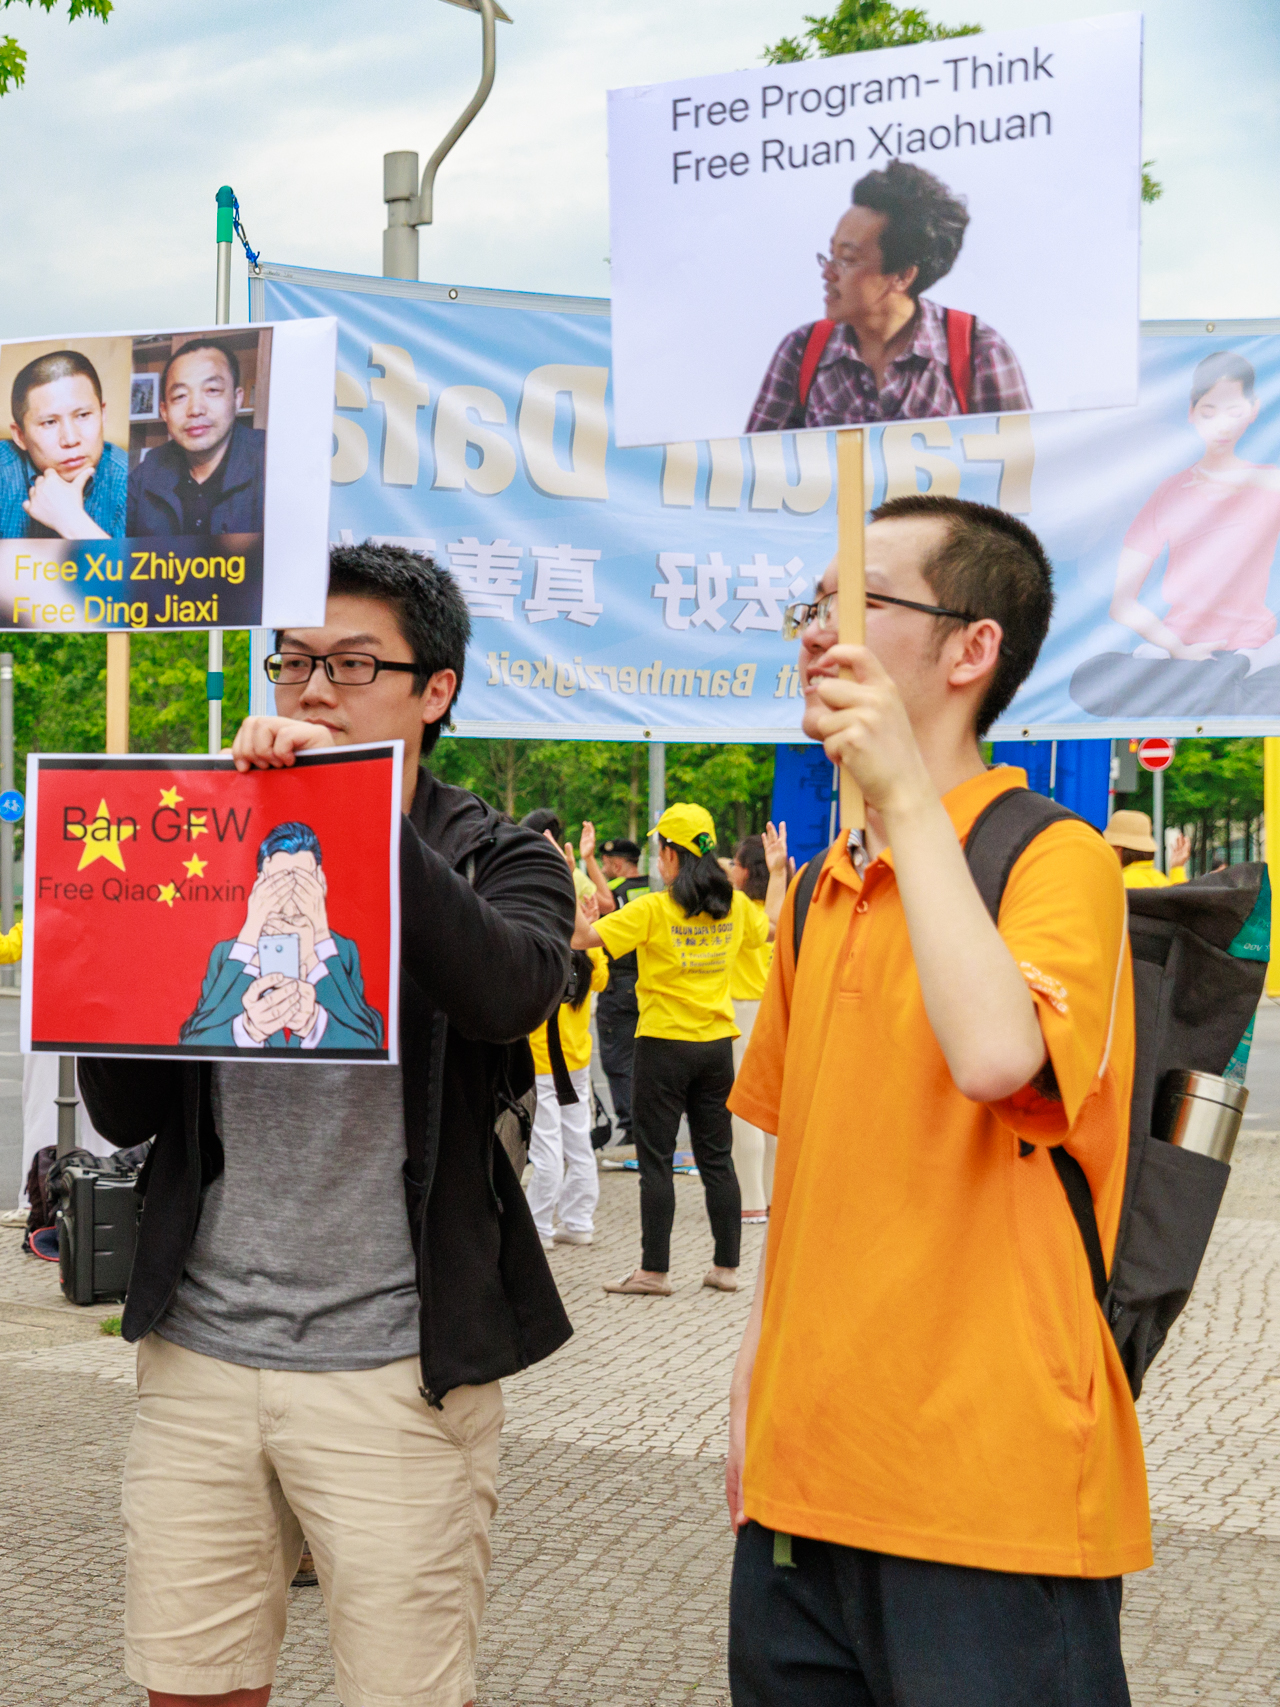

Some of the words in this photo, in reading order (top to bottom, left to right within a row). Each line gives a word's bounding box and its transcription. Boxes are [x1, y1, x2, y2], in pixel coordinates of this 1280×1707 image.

[671, 96, 749, 131] Free
[761, 46, 1054, 118] Program-Think
[672, 150, 750, 184] Free
[761, 136, 855, 173] Ruan
[867, 109, 1052, 160] Xiaohuan
[14, 554, 79, 581] Free
[84, 553, 124, 582] Xu
[130, 551, 246, 585] Zhiyong
[13, 597, 76, 624] Free
[84, 596, 149, 628] Ding
[154, 593, 219, 623] Jiaxi
[62, 805, 138, 842] Ban
[151, 806, 252, 842] GFW
[38, 876, 94, 900] Free
[102, 877, 161, 902] Qiao
[171, 878, 246, 903] Xinxin
[671, 925, 693, 935] FALUN
